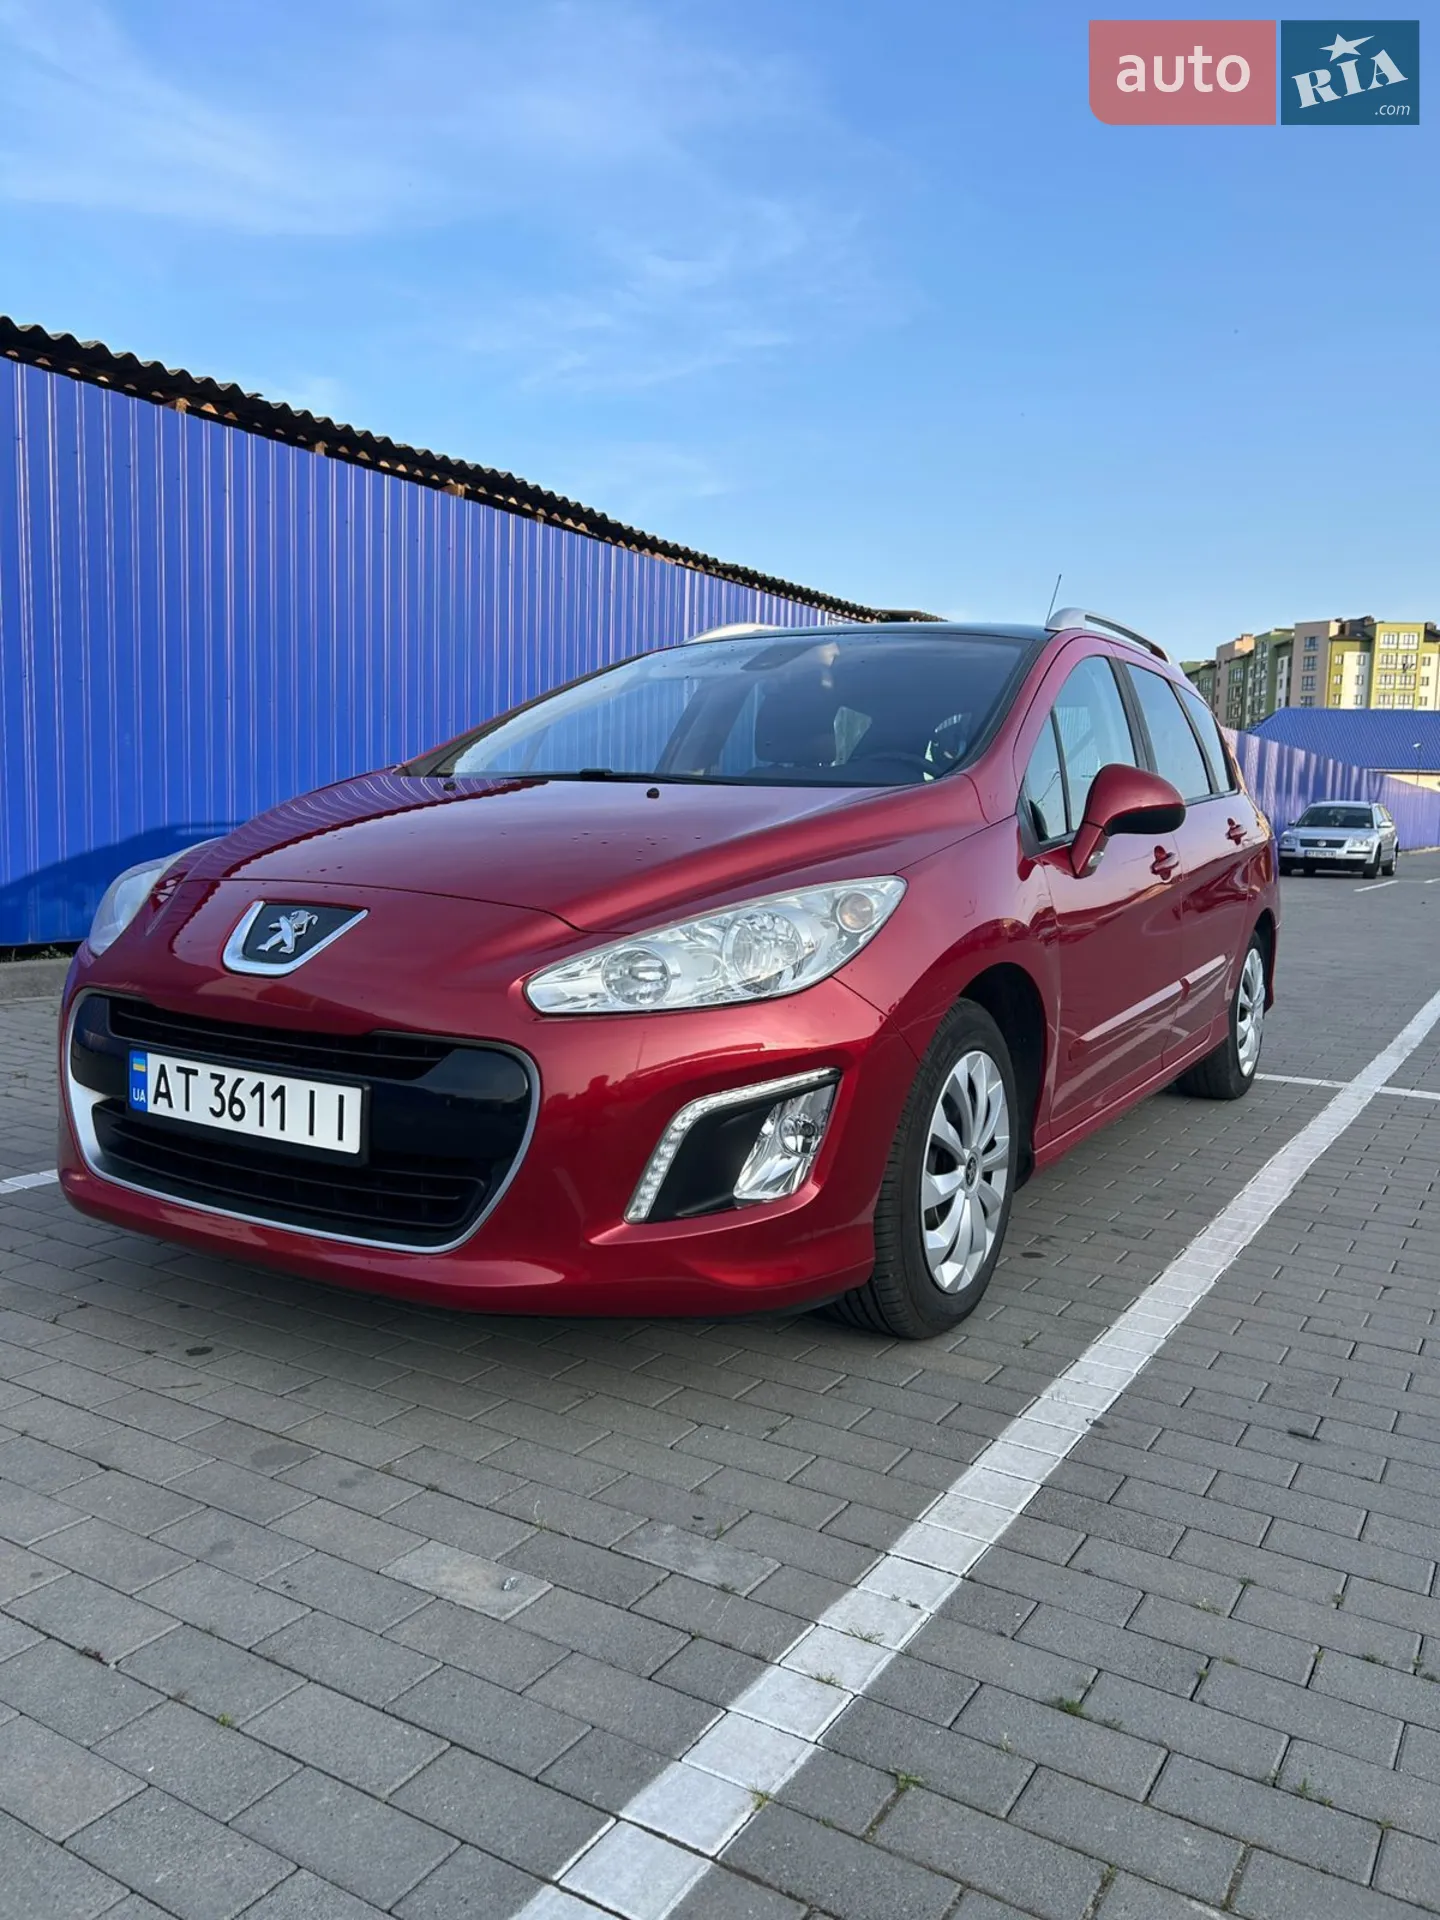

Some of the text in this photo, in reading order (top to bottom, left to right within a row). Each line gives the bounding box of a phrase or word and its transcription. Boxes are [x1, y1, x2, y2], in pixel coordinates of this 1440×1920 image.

[132, 1087, 146, 1103] UA
[153, 1064, 198, 1112] AT
[209, 1072, 286, 1131] 3611
